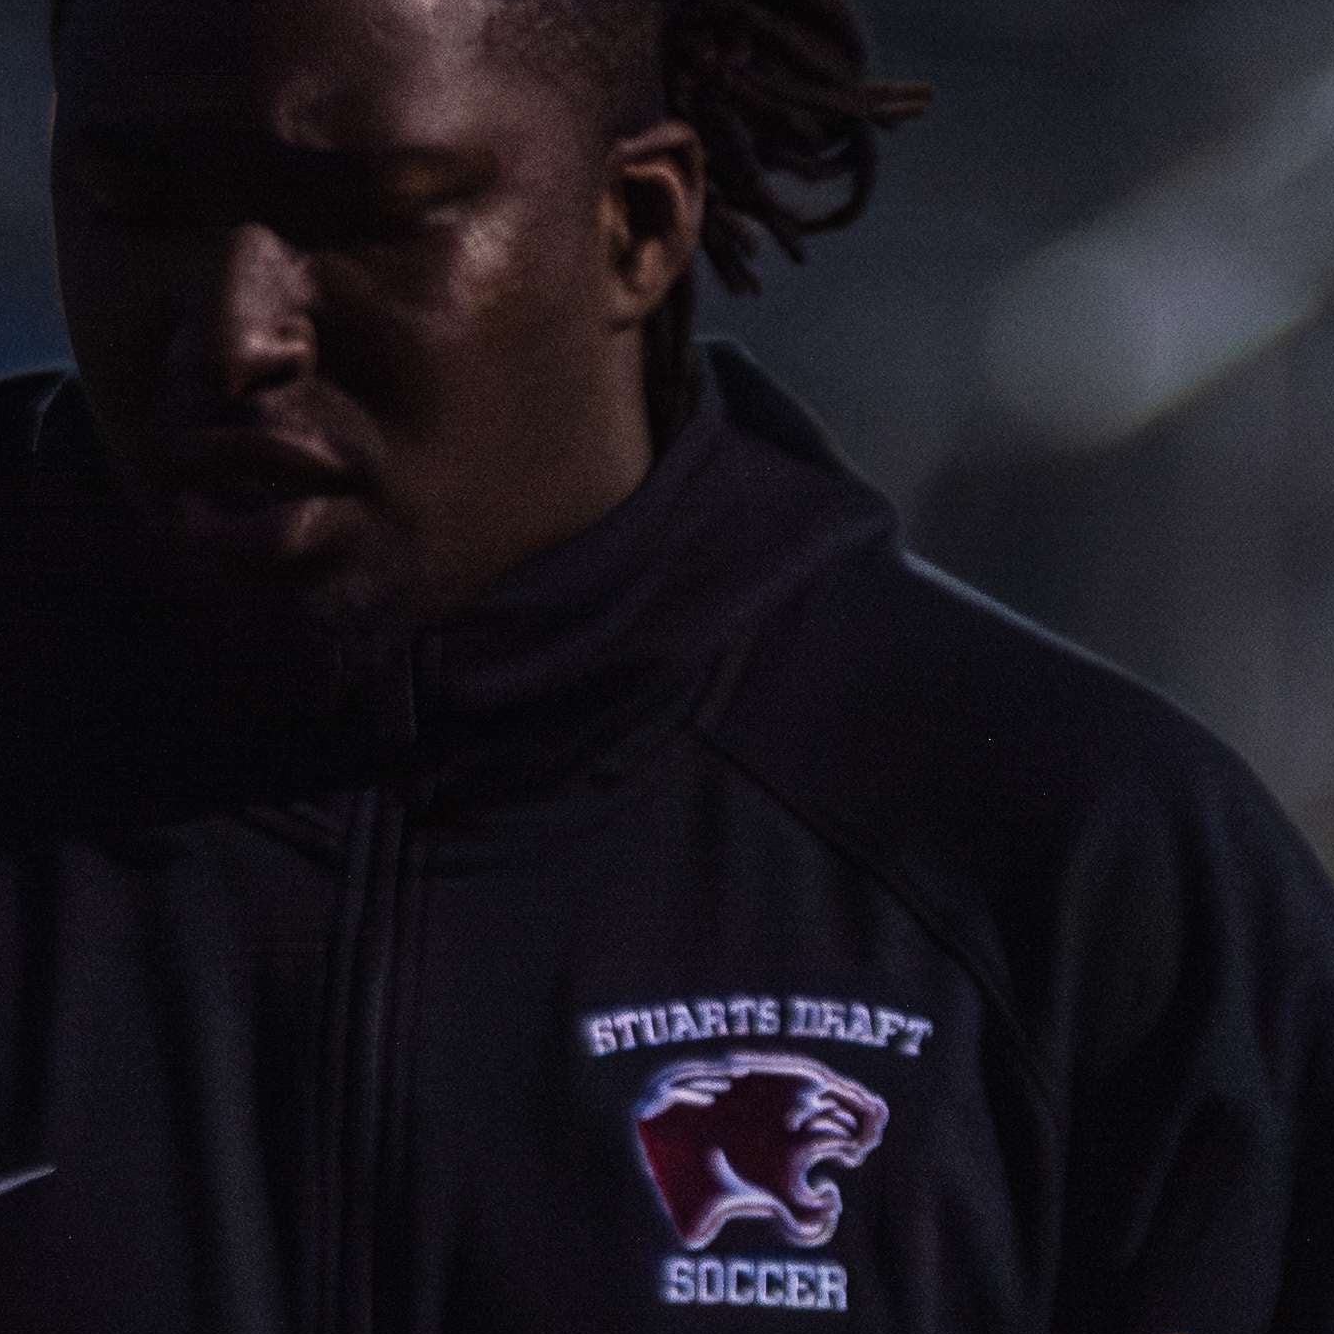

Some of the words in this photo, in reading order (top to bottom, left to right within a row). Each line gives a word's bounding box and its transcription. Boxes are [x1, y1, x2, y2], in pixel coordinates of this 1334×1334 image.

[585, 995, 781, 1058] STUARTS
[785, 995, 934, 1058] DRAFT
[660, 1256, 848, 1313] SOCCER
